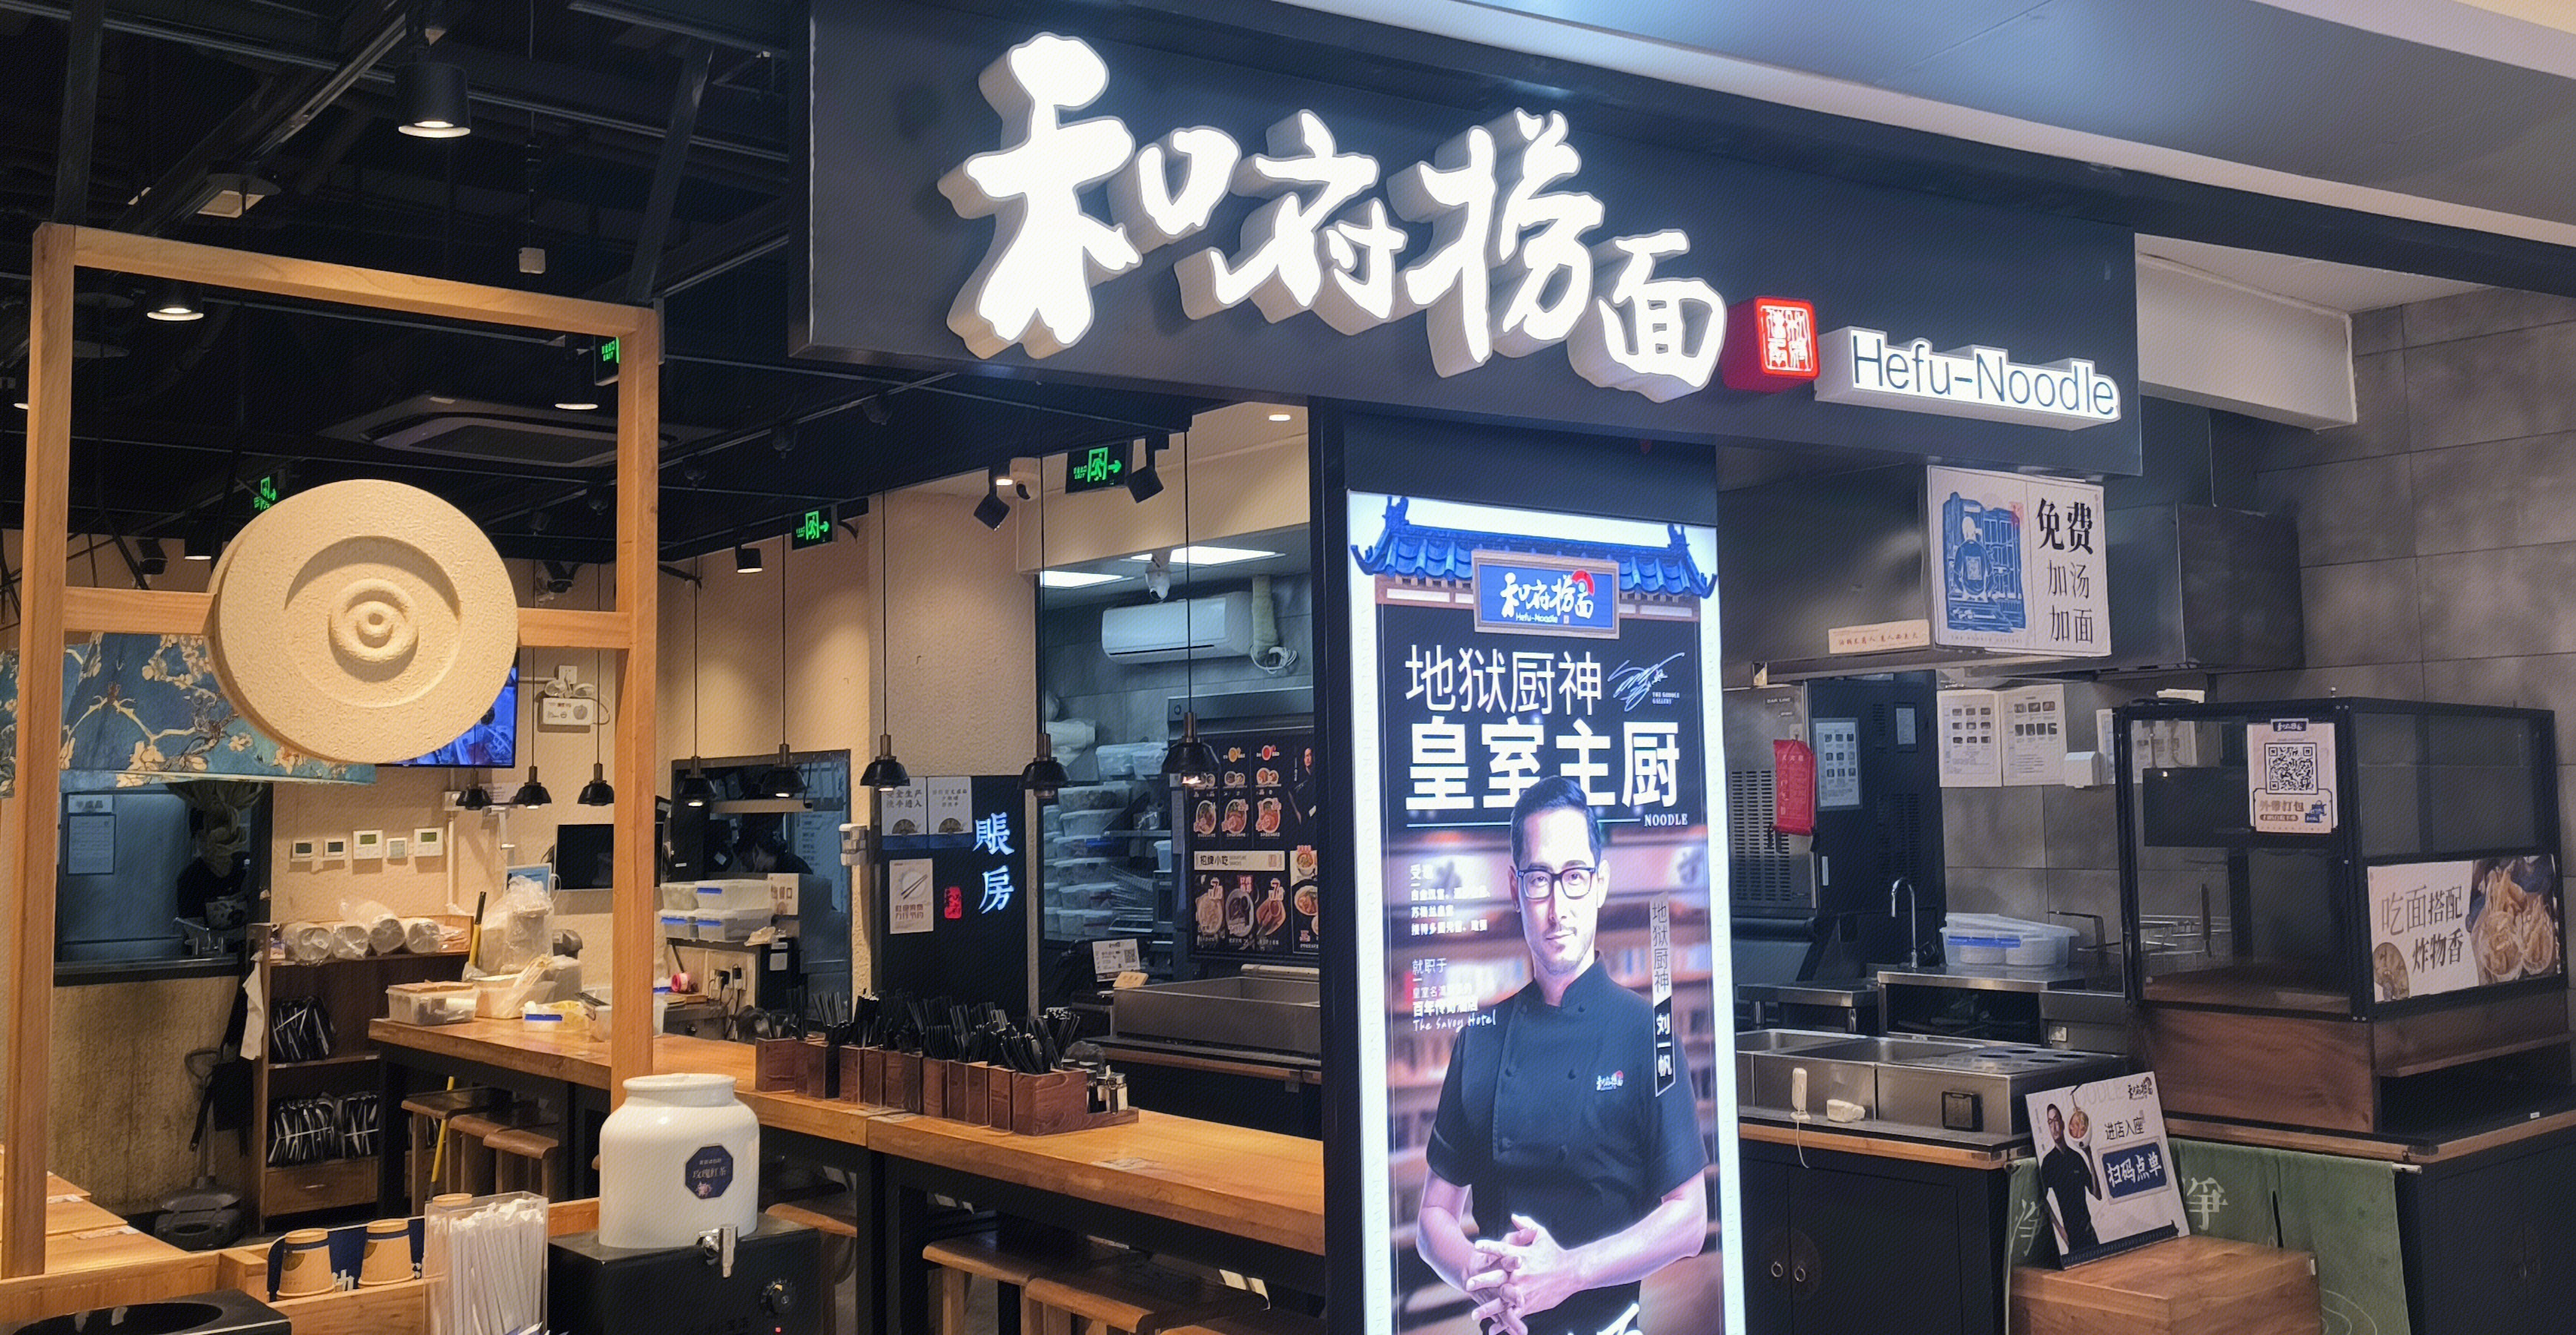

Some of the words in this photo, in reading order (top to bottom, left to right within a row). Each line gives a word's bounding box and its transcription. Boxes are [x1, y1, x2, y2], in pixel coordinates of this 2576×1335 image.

[962, 33, 1724, 387] 和府捞面
[1852, 334, 2115, 416] Hefu-Noodle
[2035, 497, 2093, 556] 免费
[1499, 572, 1594, 619] 和府捞面
[2047, 558, 2090, 600] 加汤
[2048, 604, 2094, 645] 加面
[1404, 644, 1602, 716] 地狱厨神
[1406, 715, 1680, 810] 皇室主厨
[1644, 813, 1688, 827] NOODLE
[2381, 883, 2463, 936] 吃面搭配
[1412, 957, 1447, 976] 就职于
[1651, 901, 1670, 993] 地狱厨神
[2411, 927, 2464, 975] 炸物香
[1413, 1019, 1432, 1032] The
[1467, 1009, 1496, 1028] Hotel
[1656, 1012, 1673, 1077] 刘一帆
[2104, 1116, 2145, 1141] 进店入座
[2106, 1151, 2162, 1188] 扫码点单
